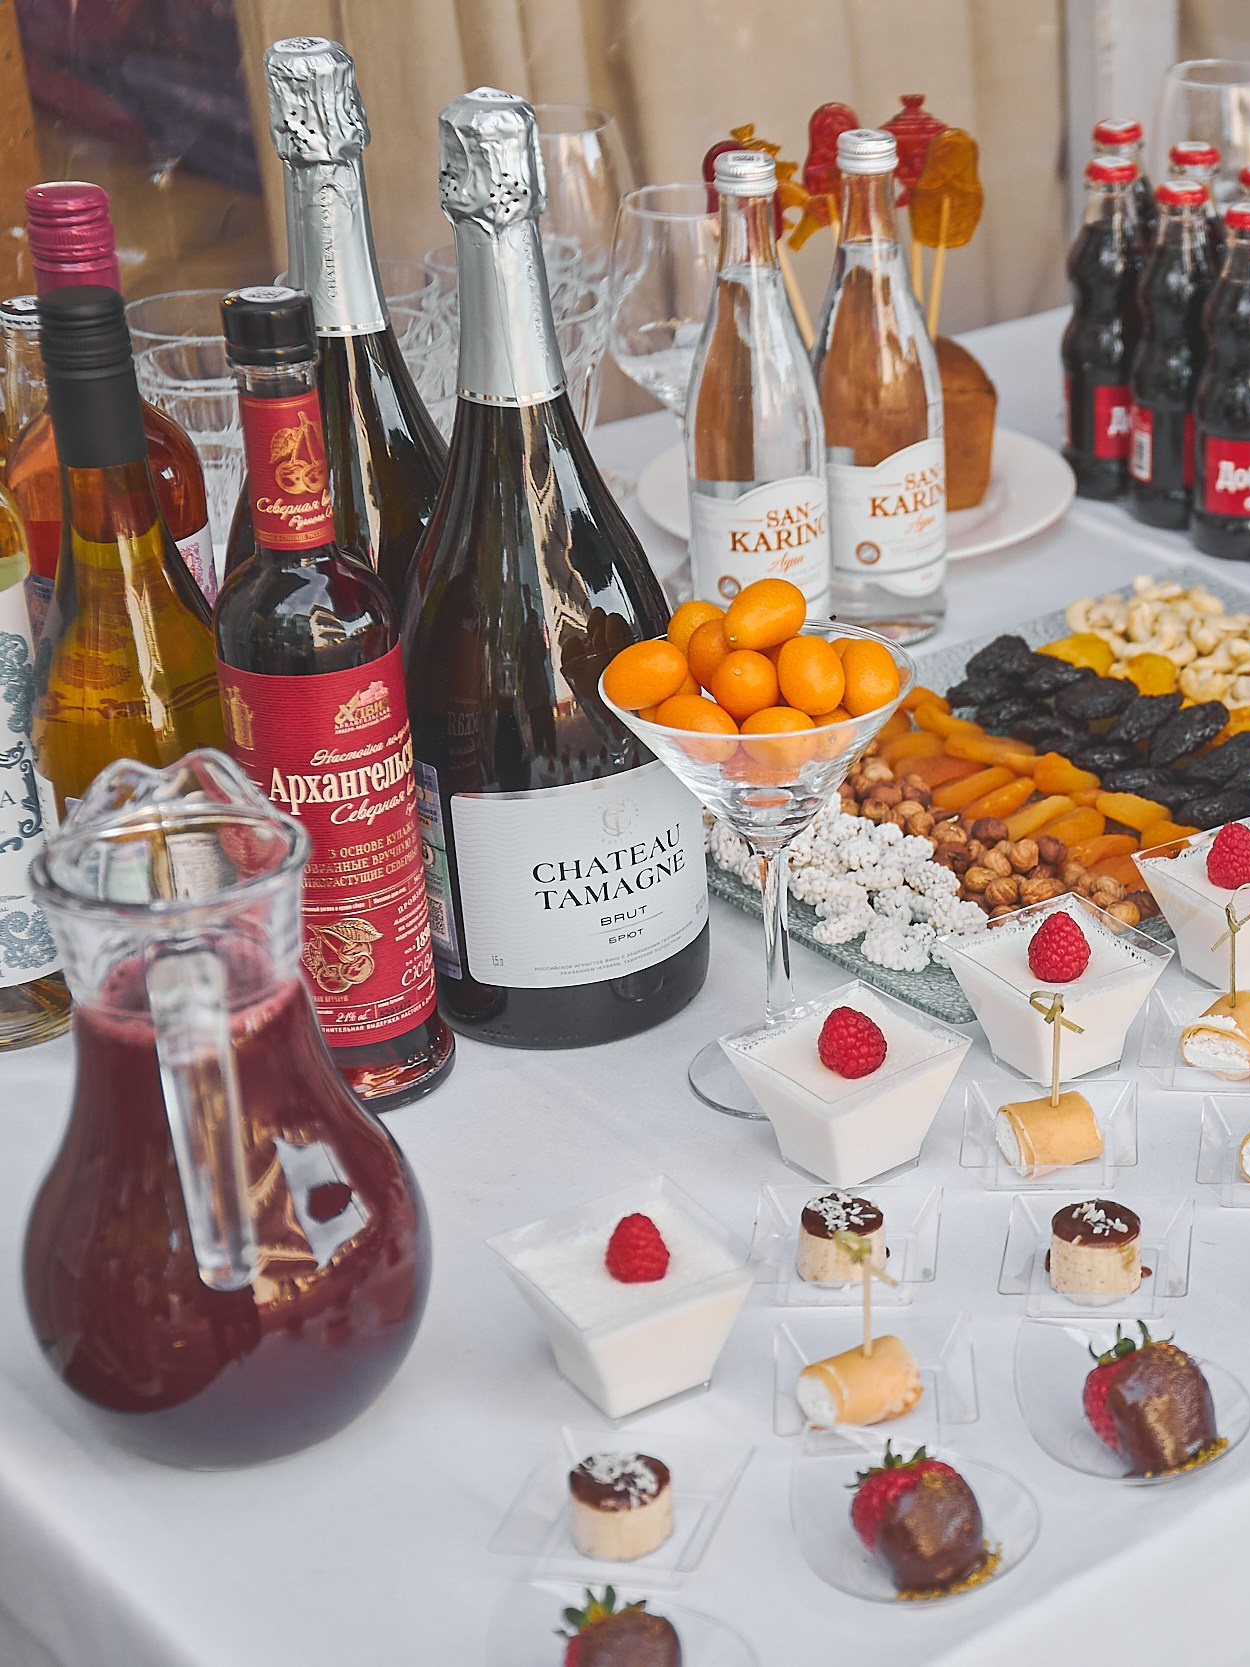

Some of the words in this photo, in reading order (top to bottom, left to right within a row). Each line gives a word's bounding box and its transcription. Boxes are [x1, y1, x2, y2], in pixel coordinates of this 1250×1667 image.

[903, 468, 940, 491] SAN
[256, 497, 319, 520] Северная
[868, 482, 945, 518] KARIN
[765, 501, 811, 528] SAN
[310, 742, 384, 767] Настойка
[330, 790, 405, 826] Северная
[340, 838, 384, 859] ОСНОВЕ
[532, 822, 681, 884] CHATEAU
[303, 857, 370, 875] ОБРАННЫЕ
[534, 849, 686, 910] TAMAGNE
[600, 904, 648, 927] BRUT
[608, 927, 644, 945] БРЮТ
